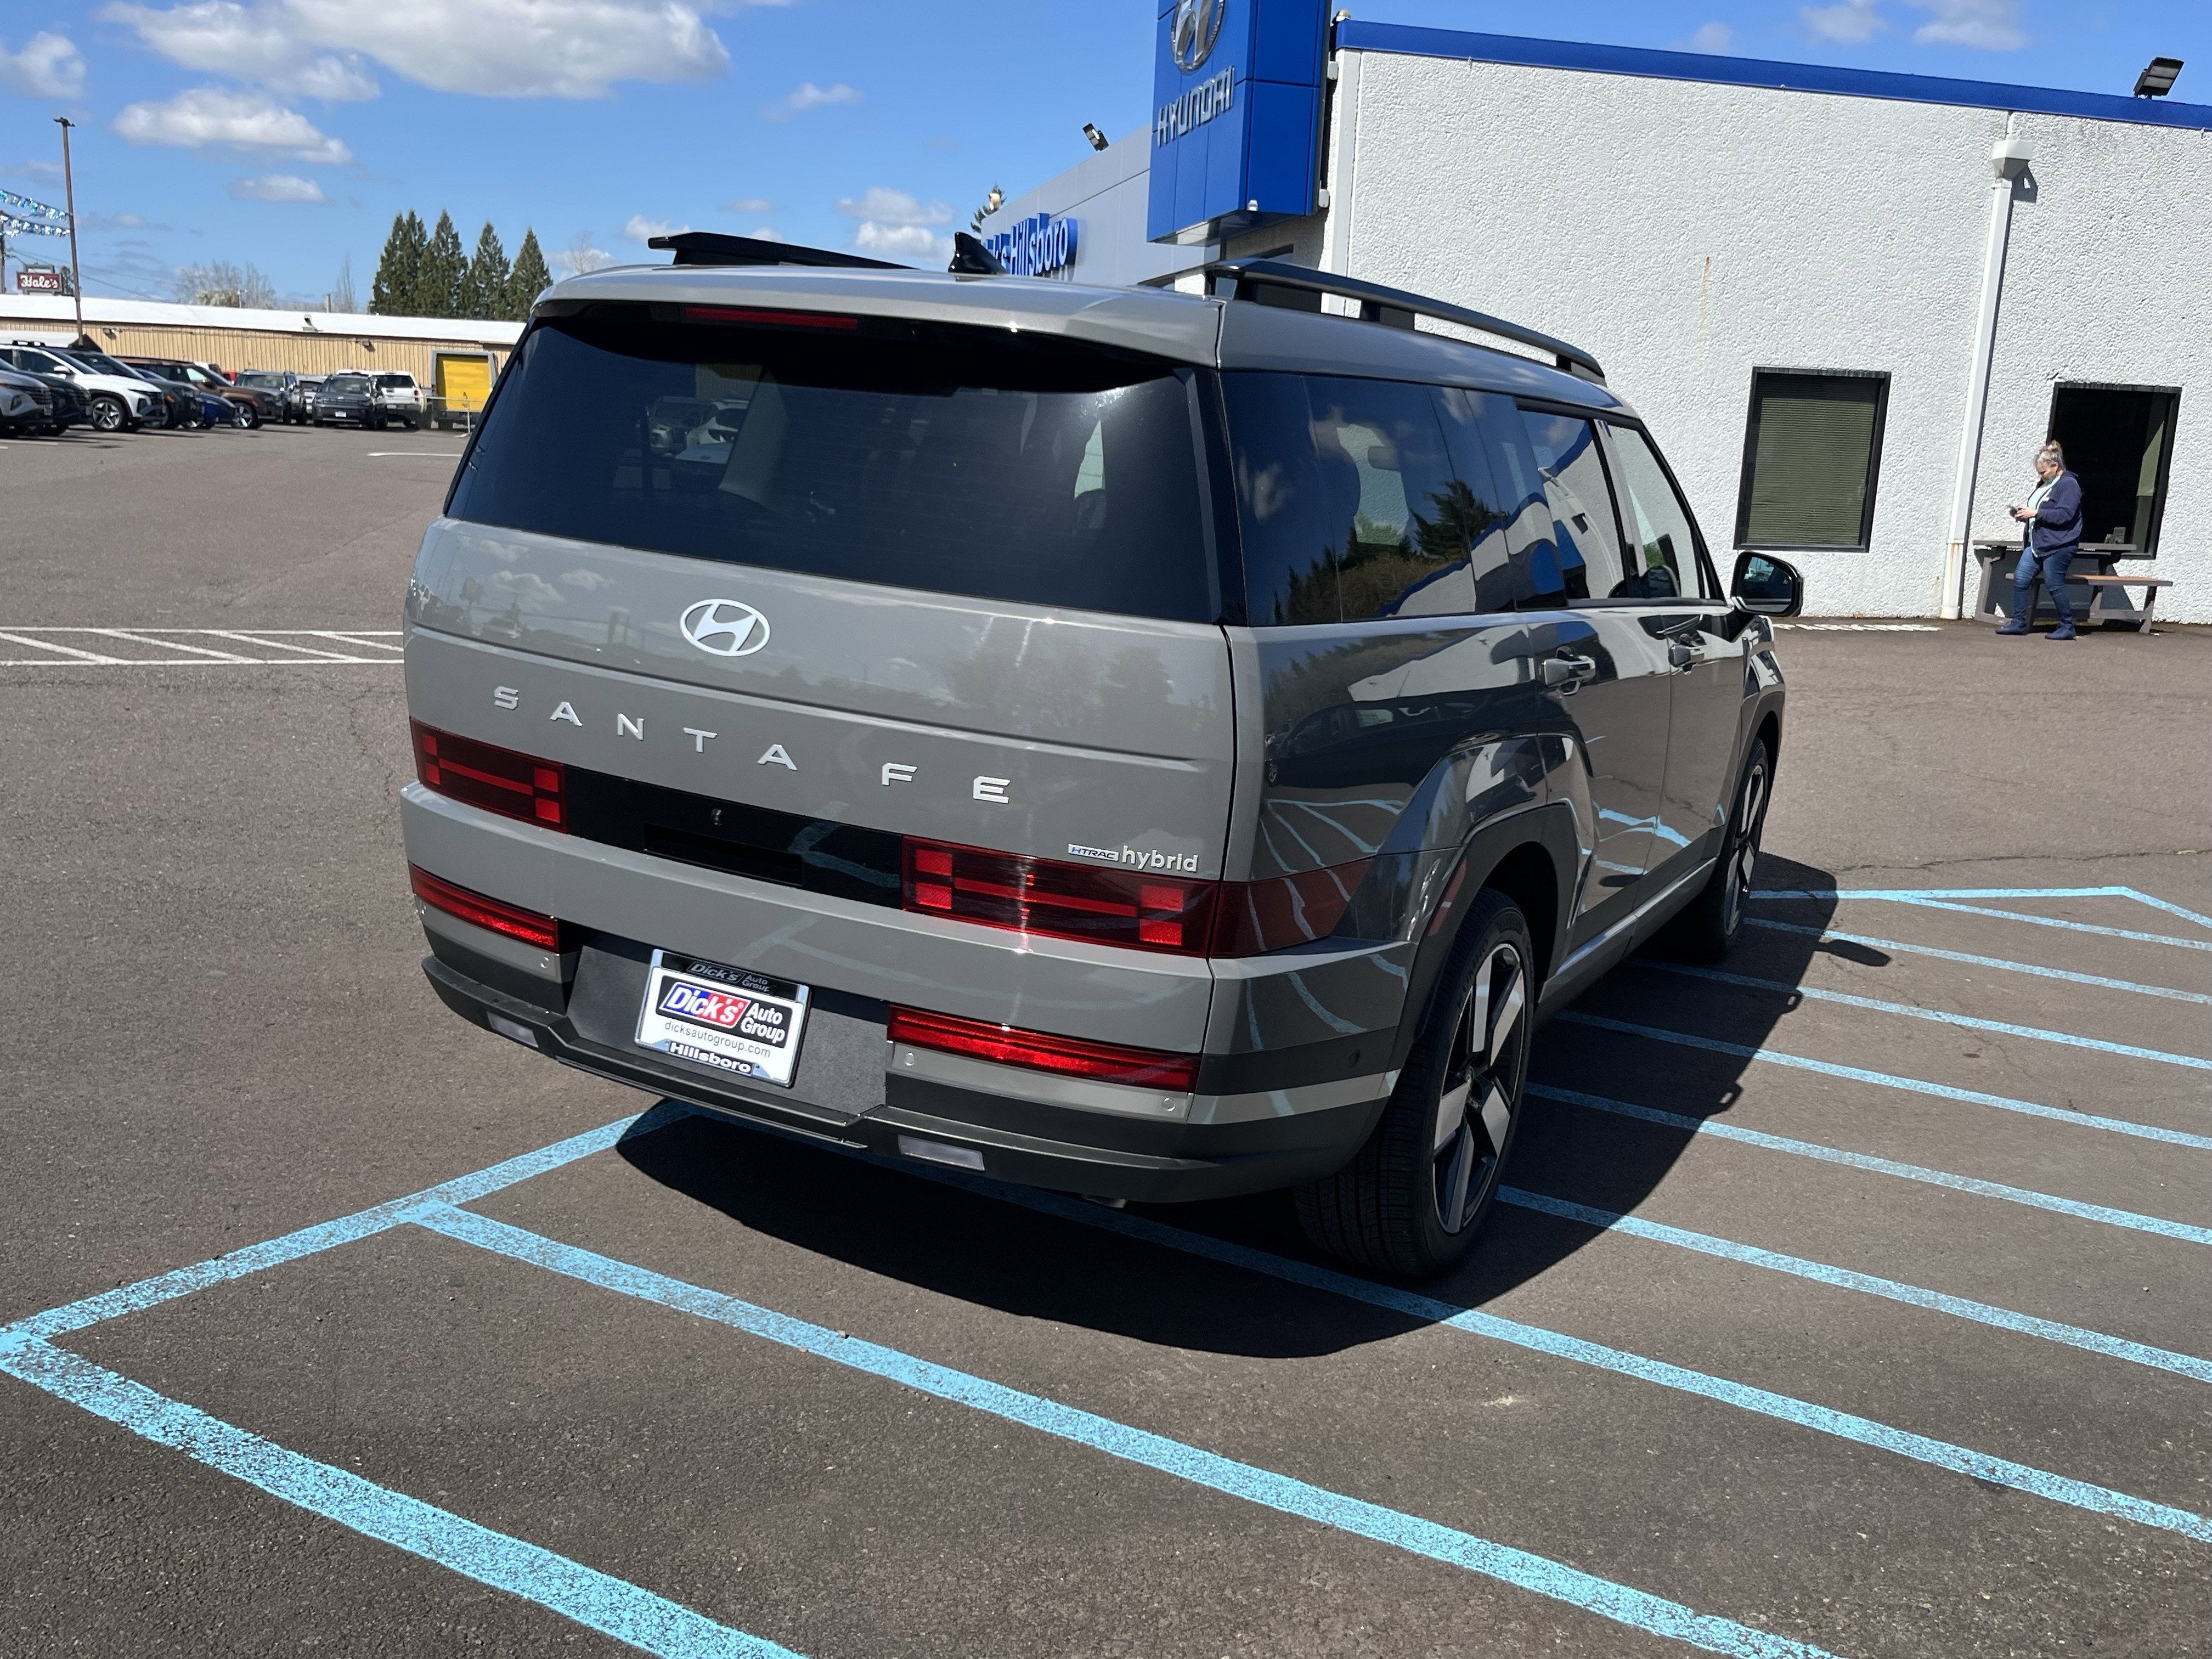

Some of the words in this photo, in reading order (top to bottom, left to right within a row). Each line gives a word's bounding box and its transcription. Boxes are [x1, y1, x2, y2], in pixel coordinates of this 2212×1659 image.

[1157, 65, 1234, 147] HYUNDAI
[1010, 213, 1070, 276] Hillsboro
[20, 275, 59, 289] Hale's
[494, 686, 798, 771] SANTA
[881, 762, 1011, 804] FE
[1071, 847, 1116, 859] HTRAC
[1122, 845, 1199, 873] hybrid
[690, 963, 740, 981] Dick's
[744, 974, 769, 985] Auto
[667, 988, 740, 1023] Dick's
[746, 1002, 783, 1025] Auto
[665, 1021, 771, 1058] dicksautogroup.com
[741, 1017, 786, 1043] Group
[670, 1042, 752, 1073] Hillsboro
